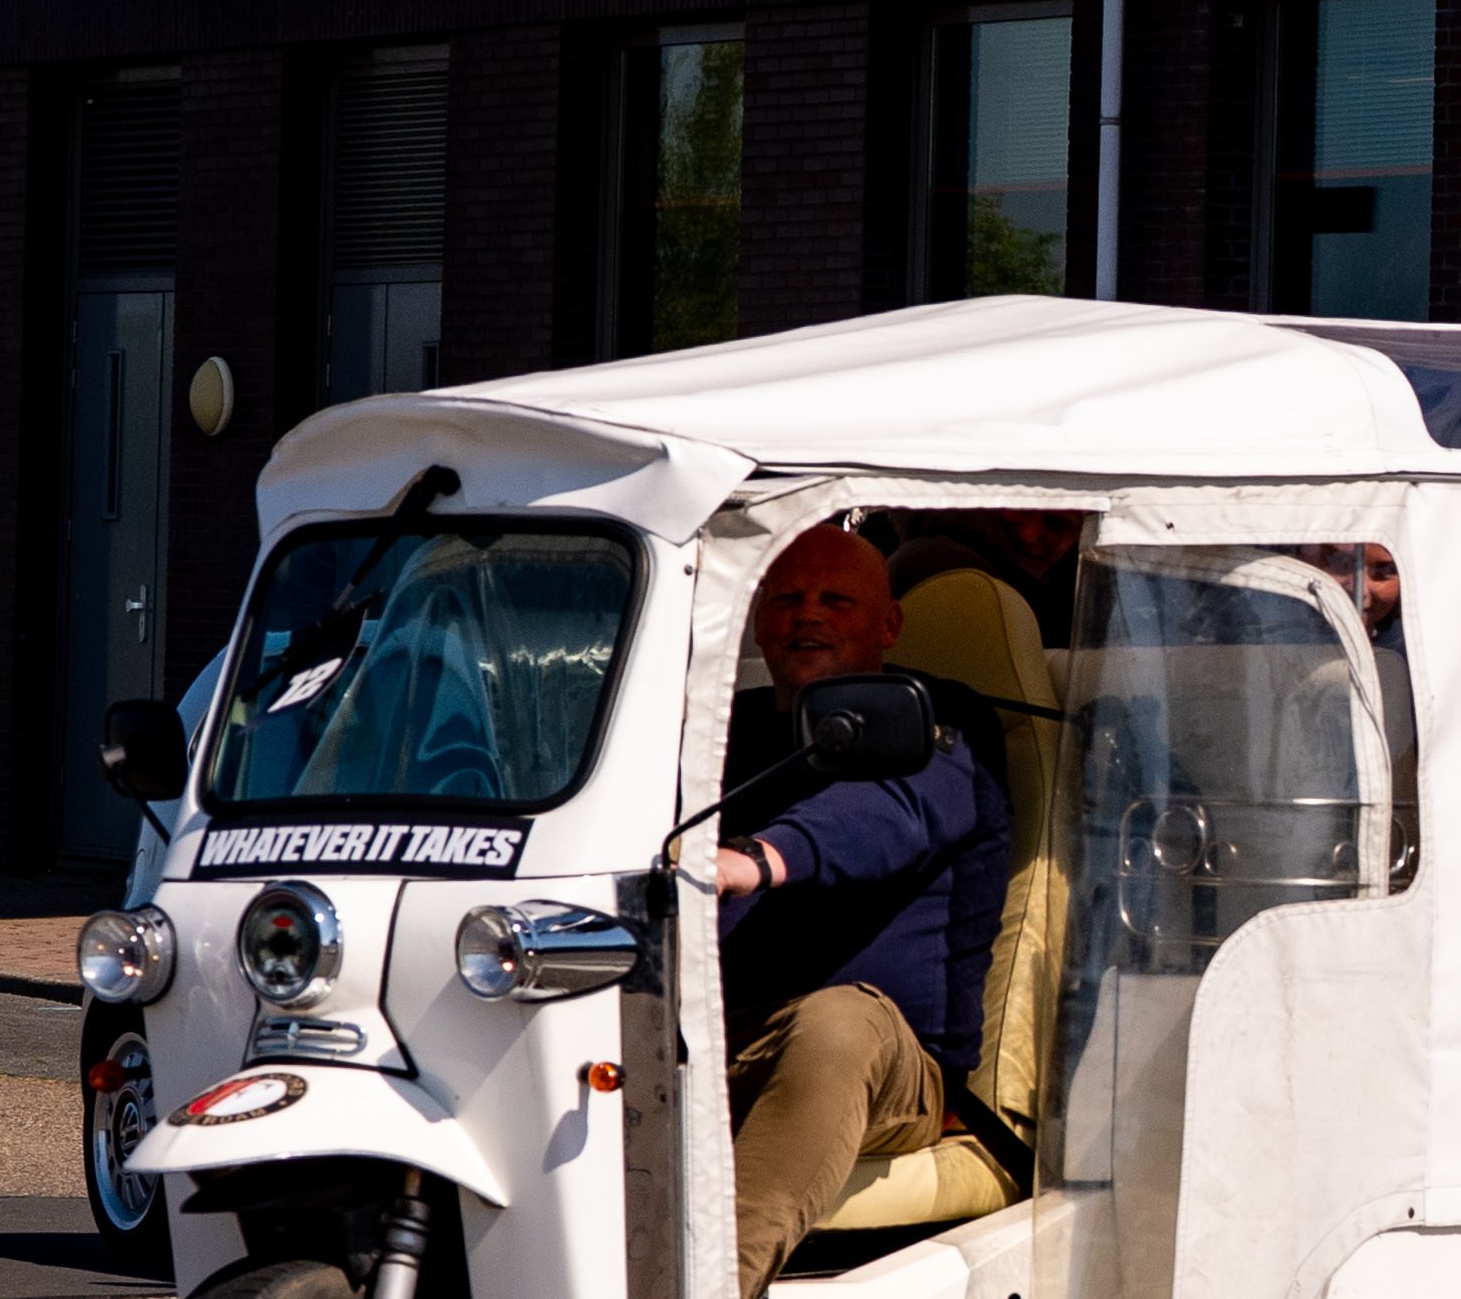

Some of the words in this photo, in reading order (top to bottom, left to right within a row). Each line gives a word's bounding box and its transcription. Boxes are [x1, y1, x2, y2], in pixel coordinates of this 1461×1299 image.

[199, 823, 374, 867] WHATEVER
[364, 824, 410, 862] IT
[400, 827, 524, 867] TAKES
